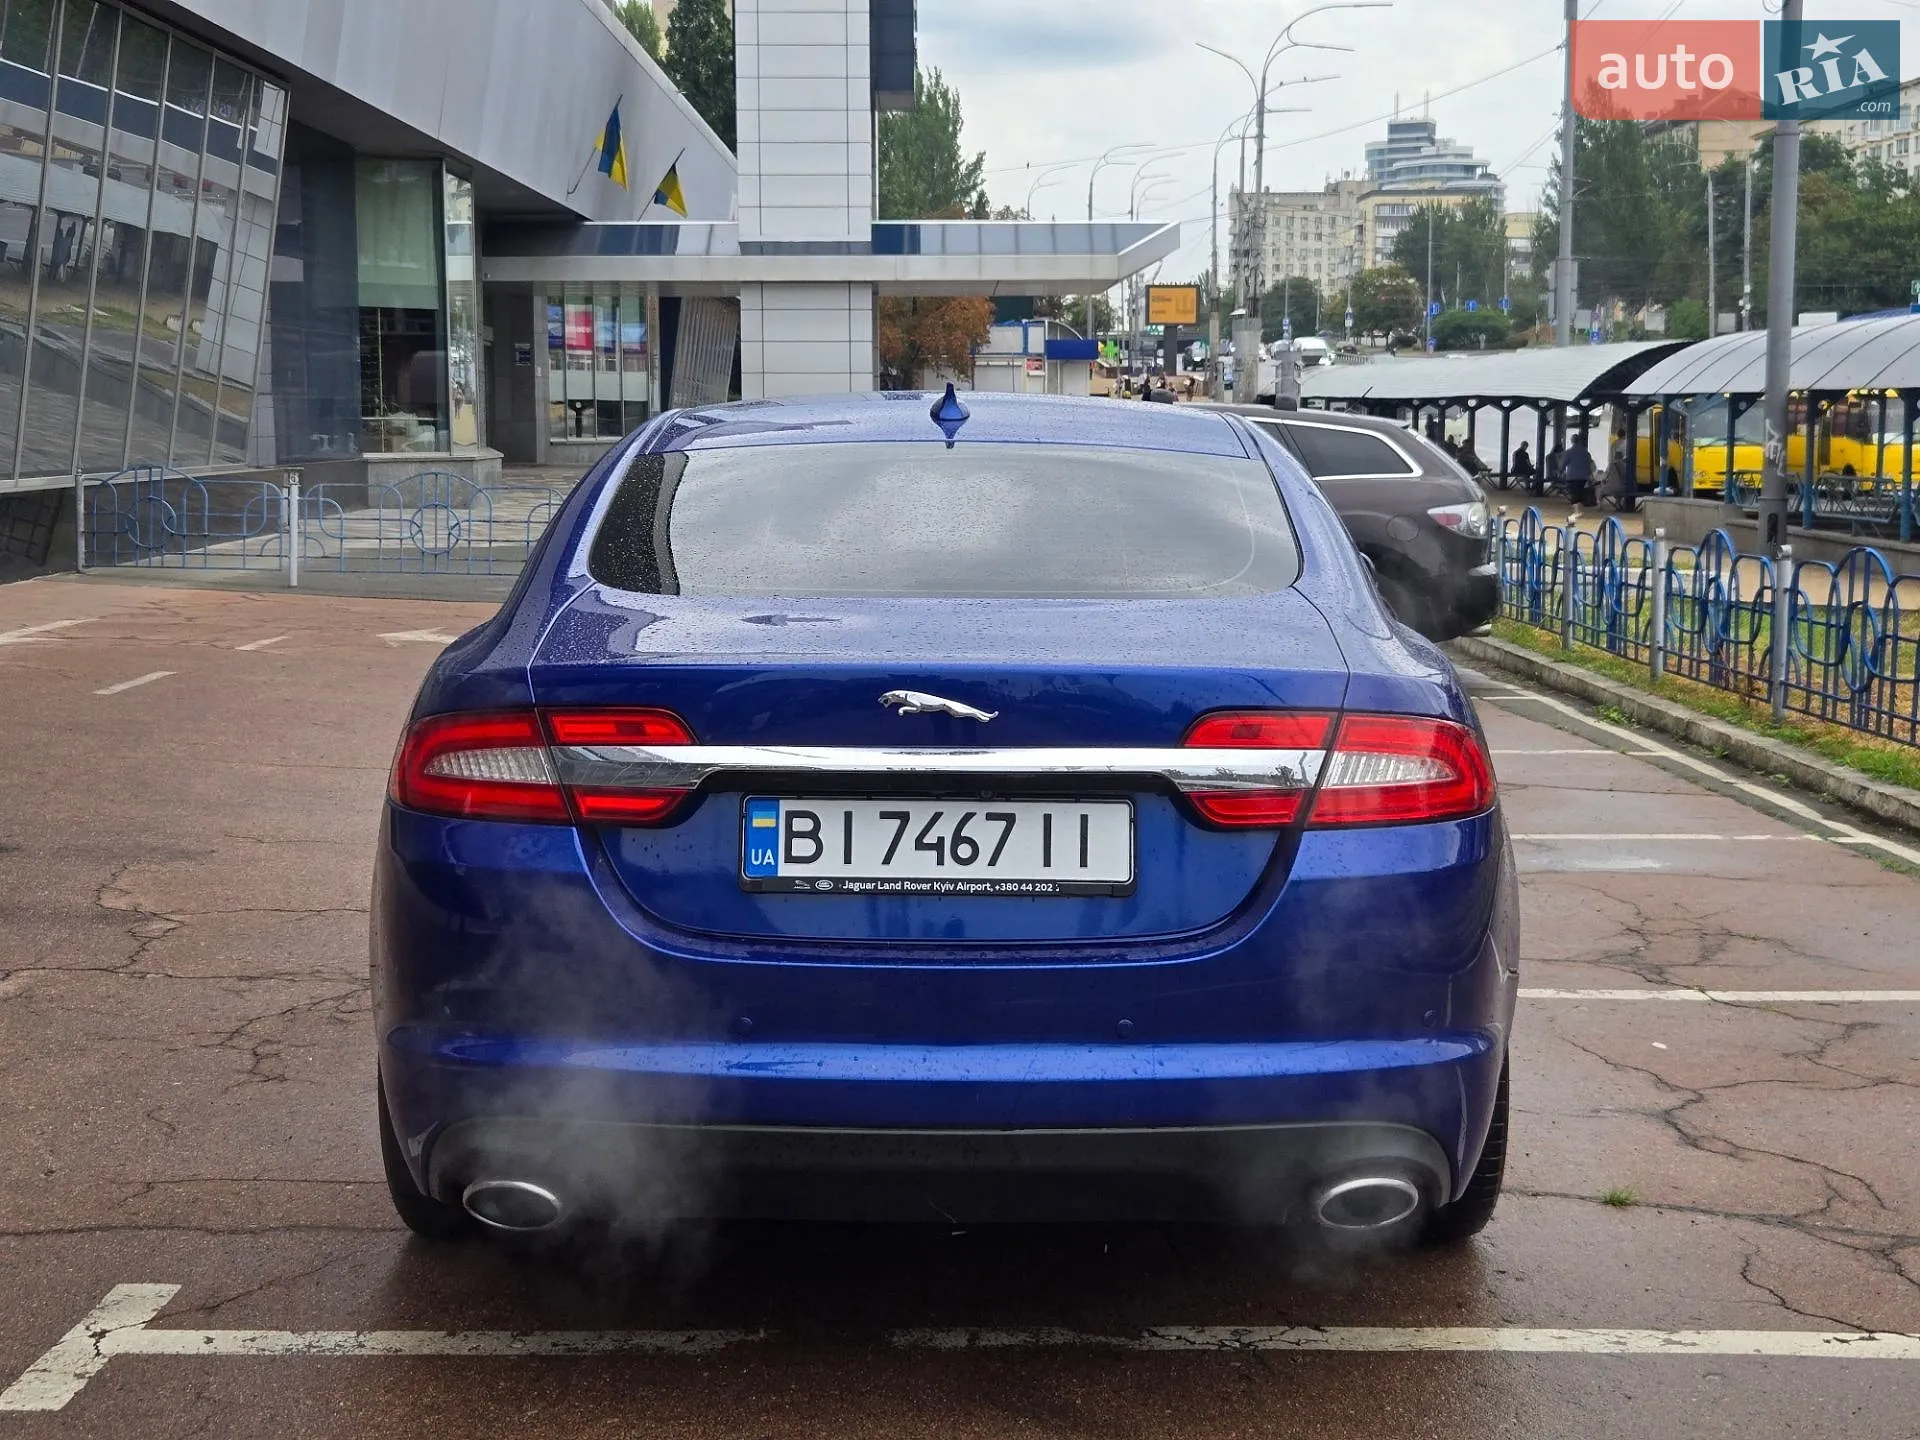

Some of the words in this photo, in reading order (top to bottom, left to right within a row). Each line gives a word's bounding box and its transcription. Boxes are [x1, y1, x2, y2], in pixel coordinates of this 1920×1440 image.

[784, 809, 852, 865] BI
[878, 810, 1017, 867] 7467
[751, 848, 775, 866] UA
[842, 880, 876, 892] Jaguar
[877, 880, 901, 890] Land
[903, 881, 931, 891] Rover
[933, 881, 954, 893] Kyiv
[956, 881, 994, 893] Airport,
[995, 882, 1018, 892] +380
[1020, 882, 1033, 892] 44
[1034, 883, 1053, 892] 202
